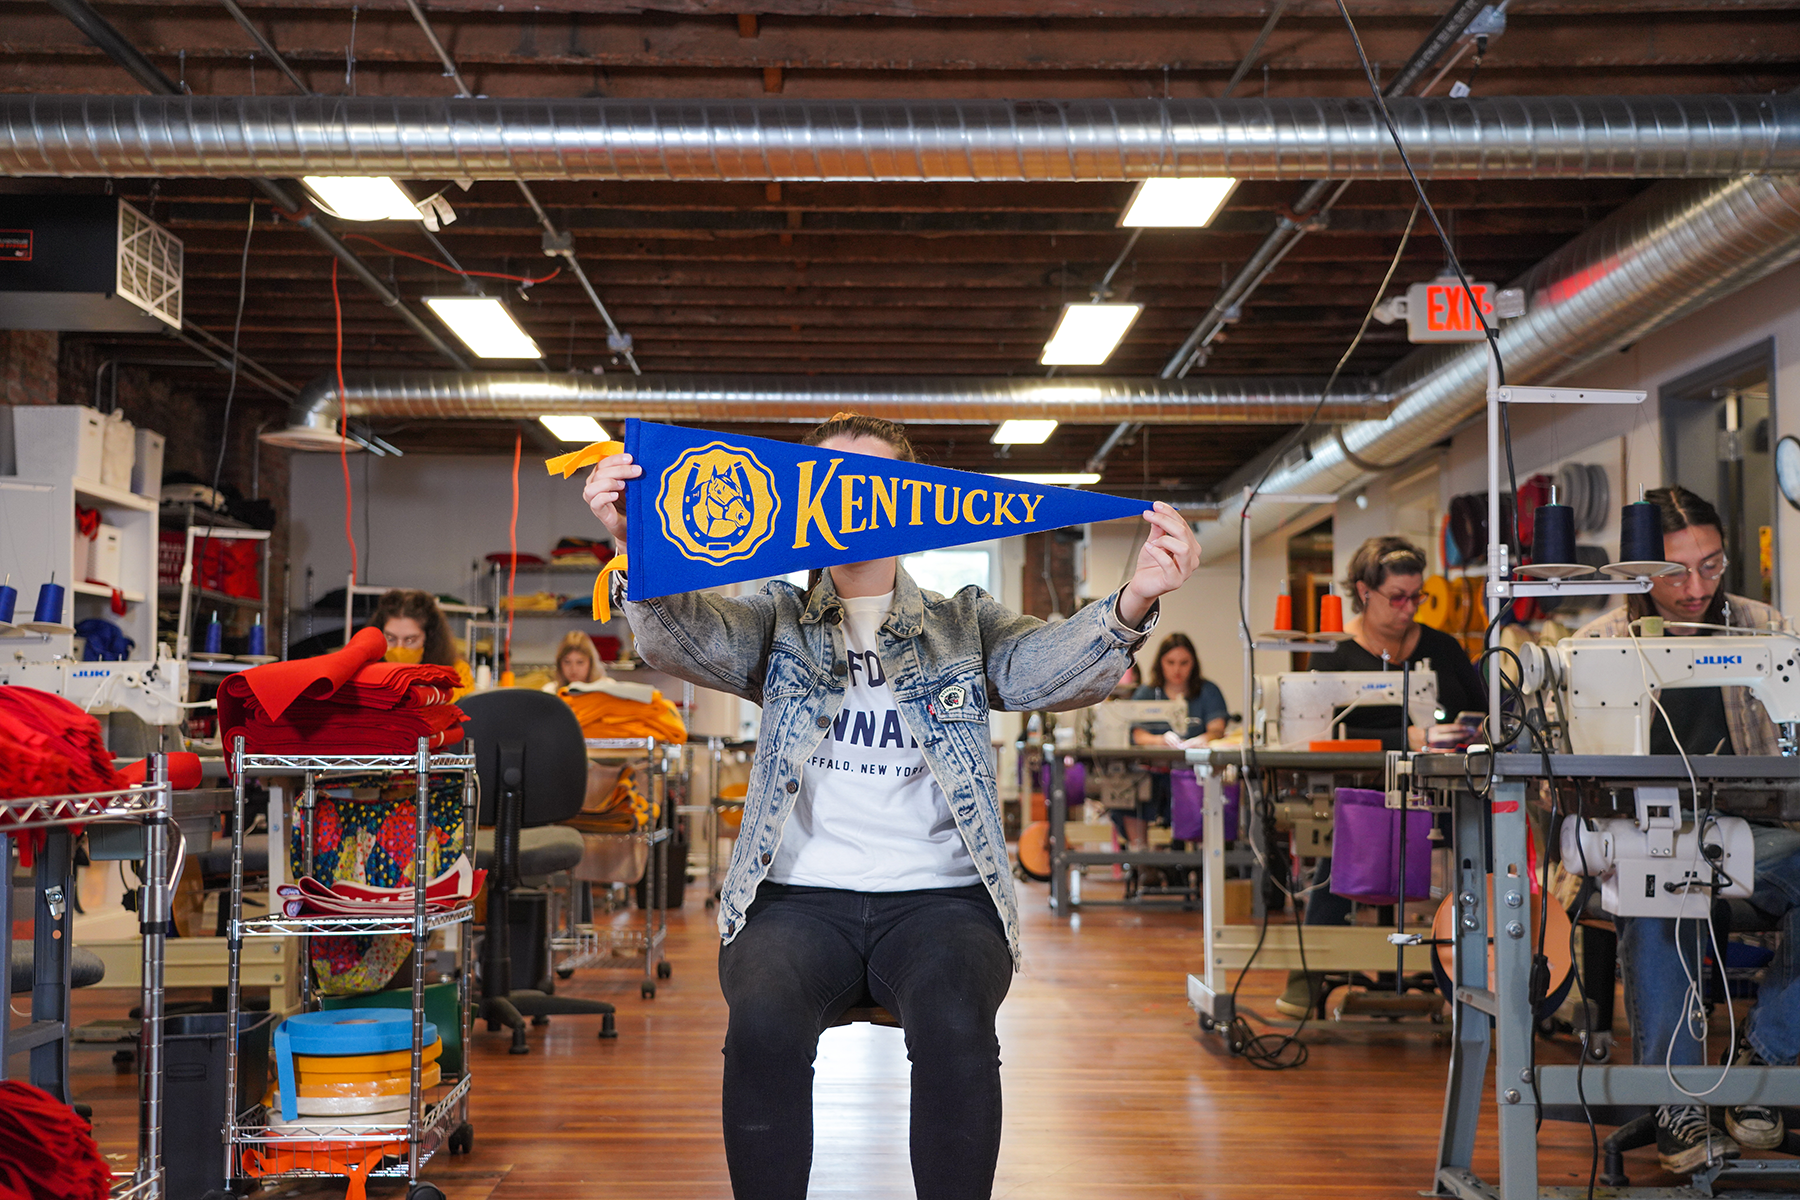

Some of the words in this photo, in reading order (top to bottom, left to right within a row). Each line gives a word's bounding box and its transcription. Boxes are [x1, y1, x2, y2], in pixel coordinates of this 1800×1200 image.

[1426, 285, 1487, 331] EXIT
[1695, 656, 1742, 664] JUKI
[72, 670, 110, 678] JUKI
[860, 763, 887, 776] NEW
[895, 765, 925, 777] YORK
